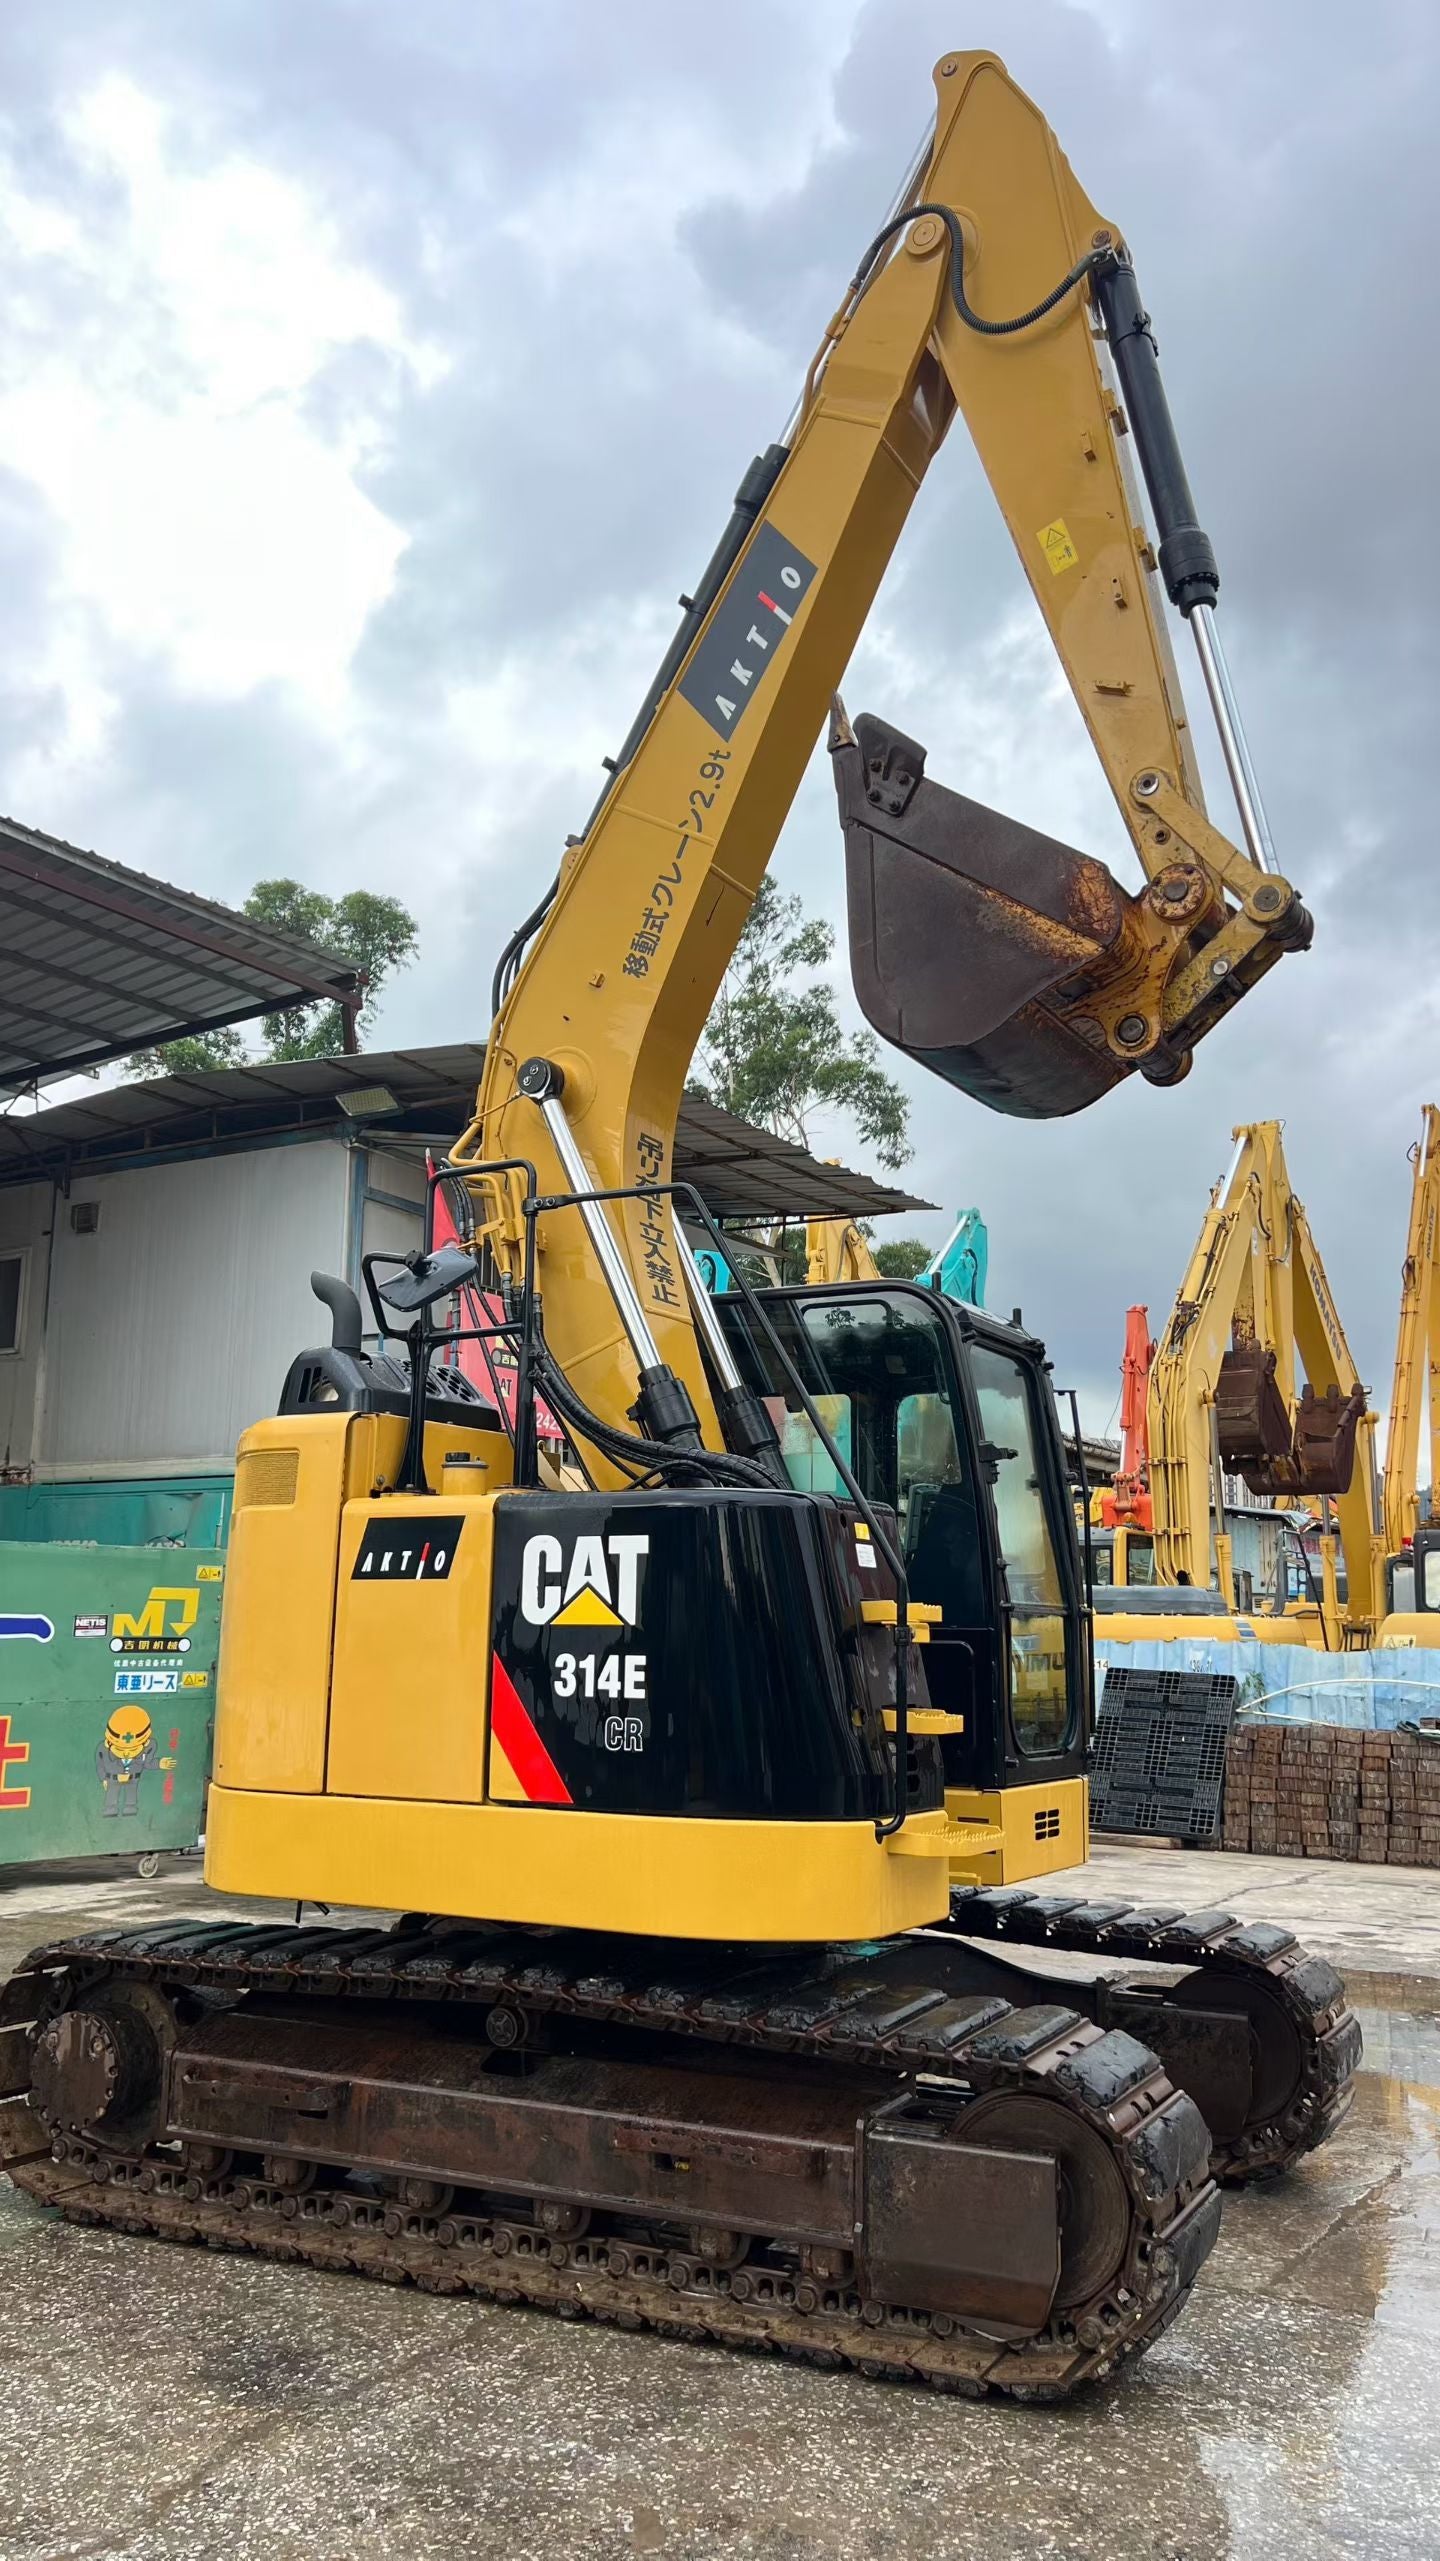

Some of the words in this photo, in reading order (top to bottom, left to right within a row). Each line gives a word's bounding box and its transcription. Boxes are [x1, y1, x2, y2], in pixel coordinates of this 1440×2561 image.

[715, 566, 801, 720] AKTIO
[622, 749, 732, 978] 移動式クレーン2.9t
[1310, 1263, 1341, 1360] KOMATSU
[361, 1542, 446, 1580] AKTIO
[521, 1534, 649, 1625] CAT
[76, 1618, 107, 1627] NETIS
[117, 1674, 176, 1690] 東亜リース
[554, 1653, 647, 1699] 314E
[604, 1716, 643, 1752] CR
